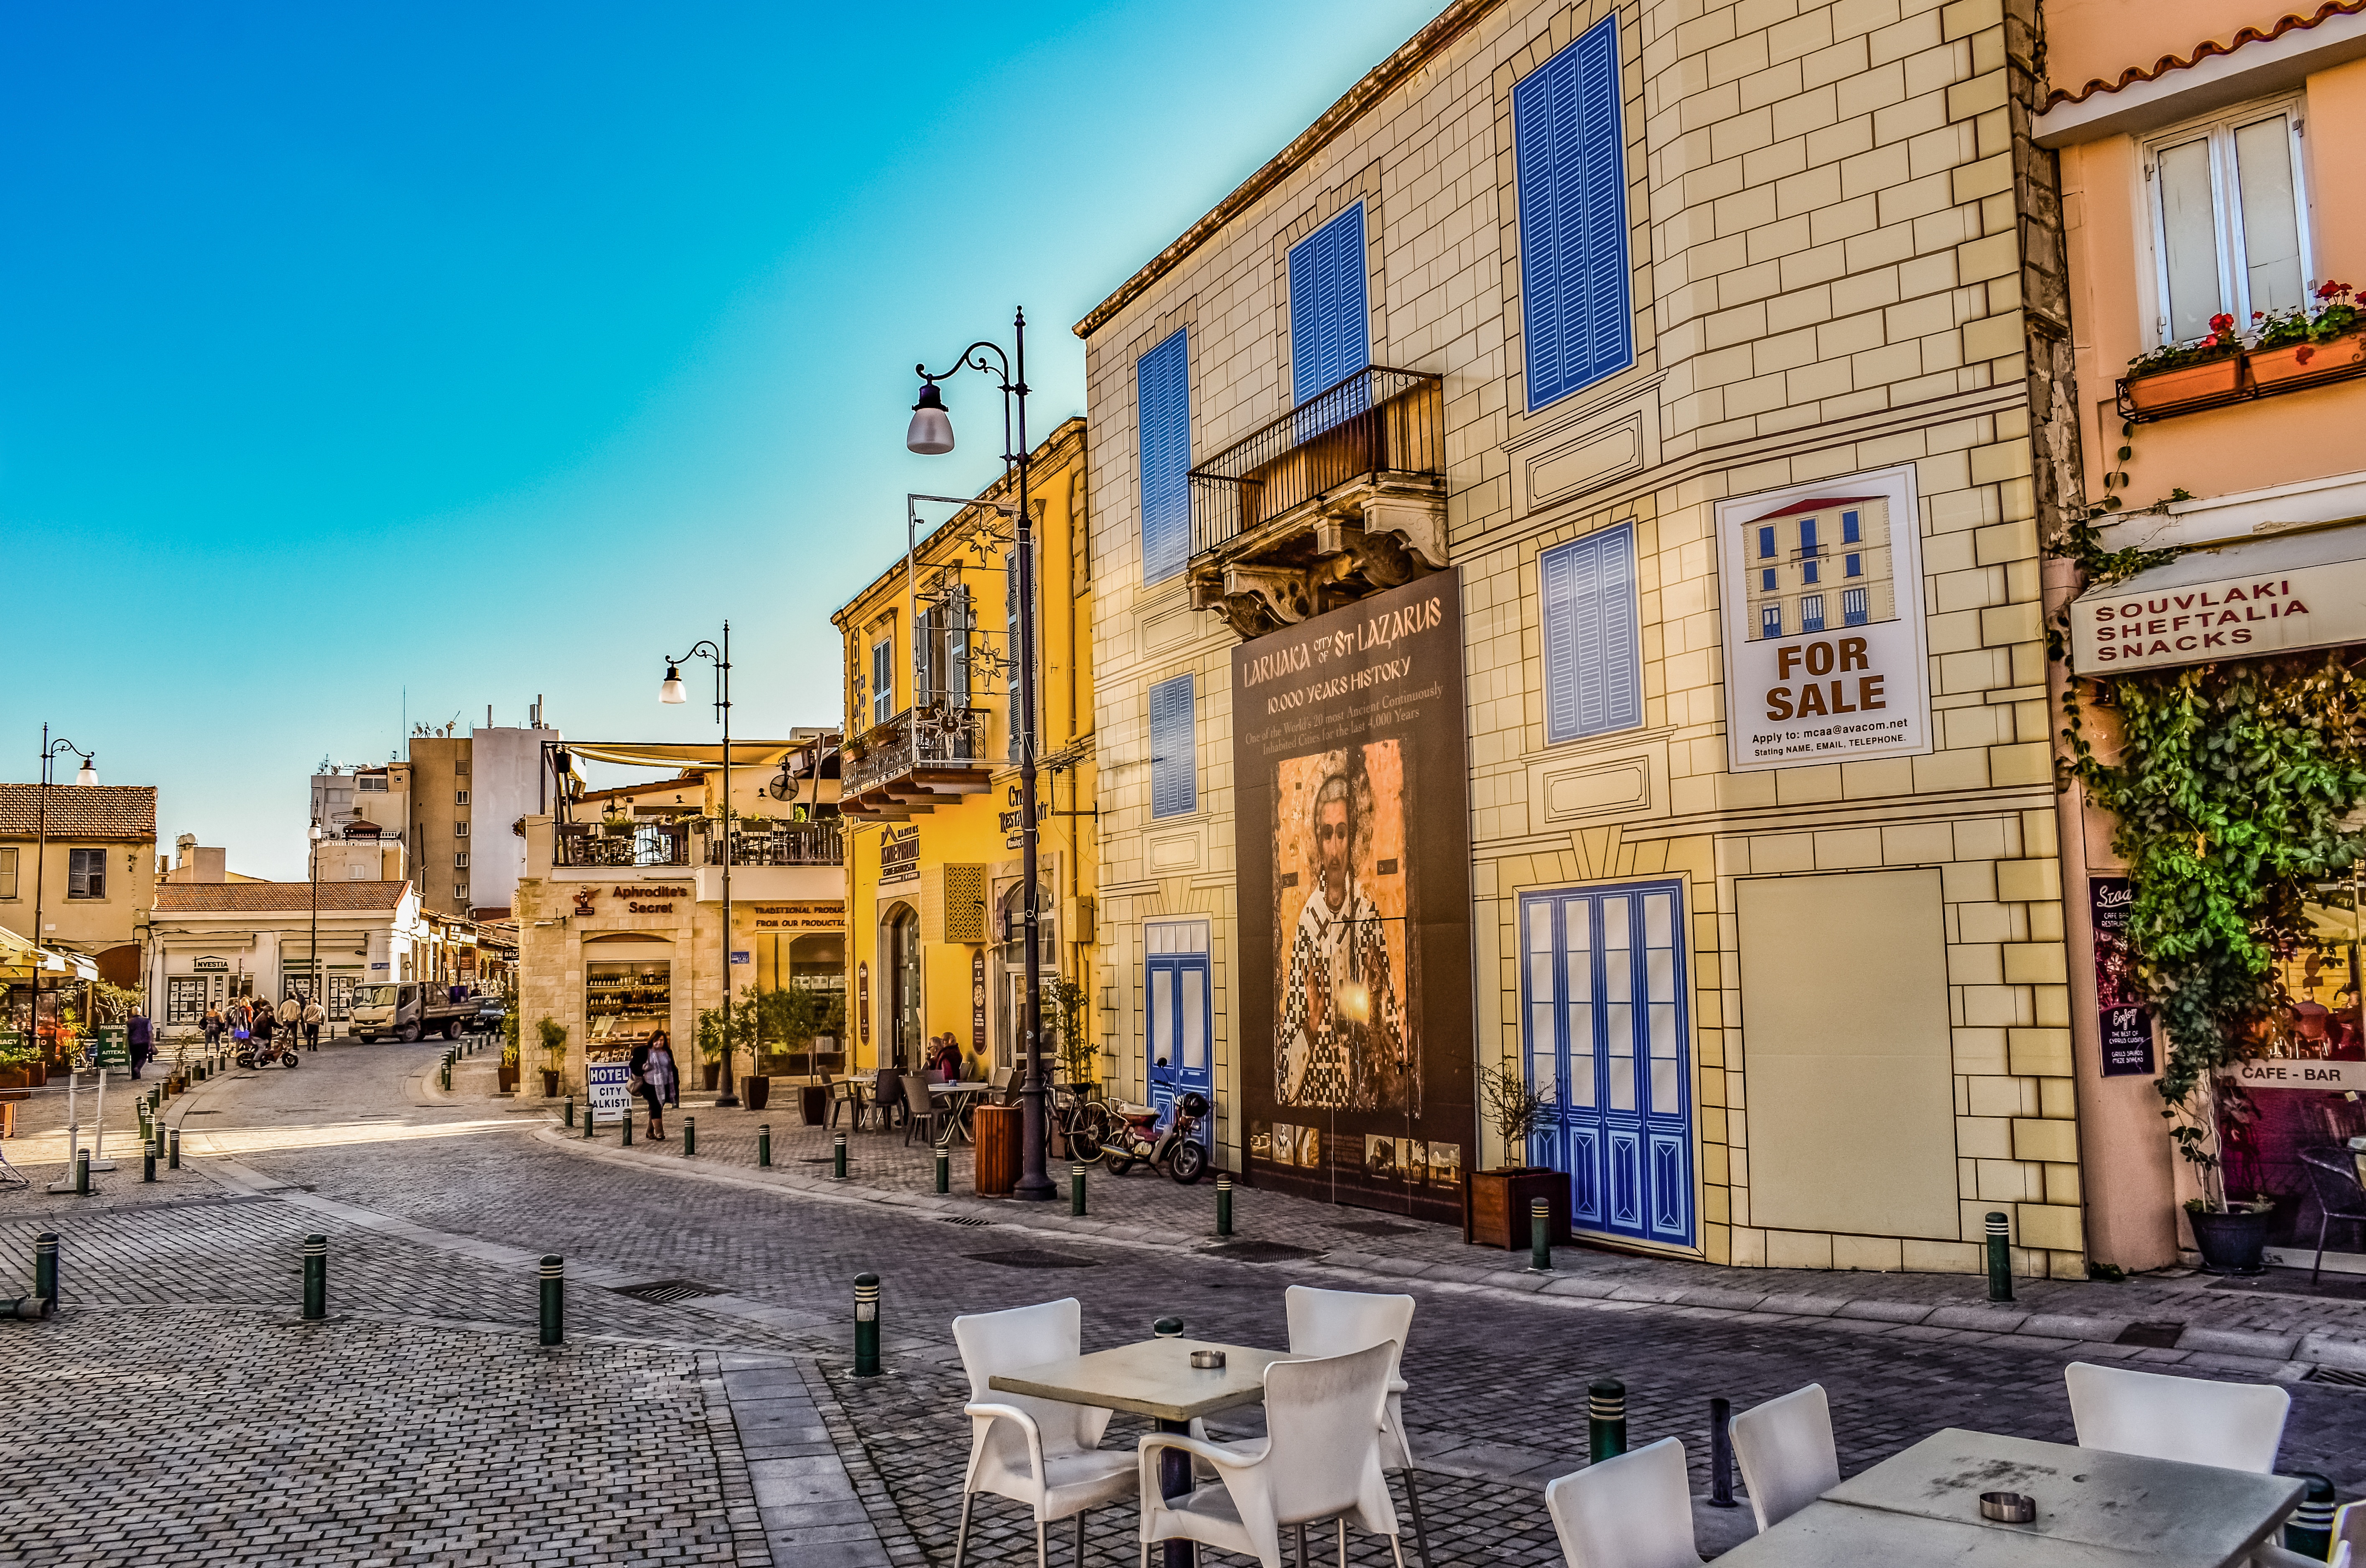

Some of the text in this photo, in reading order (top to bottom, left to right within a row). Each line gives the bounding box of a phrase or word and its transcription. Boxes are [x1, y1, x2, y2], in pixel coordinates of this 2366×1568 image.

[2096, 580, 2289, 621] SOUVLAKI
[1358, 597, 1442, 652] LAZARUS
[2096, 600, 2309, 641] SHEFTALIA
[1314, 635, 1332, 652] CITY
[2098, 629, 2252, 661] SNACKS
[1244, 643, 1310, 687] LARNAKA
[1318, 651, 1328, 663] OF
[1777, 636, 1869, 681] FOR
[1268, 656, 1411, 715] 10.000 YEARS HISTORY
[1766, 675, 1886, 721] SALE
[1245, 681, 1443, 744] One of the World's 20 most Ancient Continuously
[1263, 735, 1296, 755] Inhabited
[1299, 732, 1320, 746] Cities
[1322, 728, 1334, 740] for
[1336, 723, 1349, 737] the
[1351, 720, 1365, 733] last
[1394, 708, 1420, 722] Years
[1752, 733, 1782, 744] Apply
[1804, 718, 1908, 738] mcaa@avacom.net
[1755, 734, 1906, 756] Stating NAME, EMAIL, TELEPHONE.
[613, 886, 687, 899] Aphrodite's
[629, 901, 672, 913] Secret
[2113, 1008, 2137, 1030] Enjoy
[591, 1069, 629, 1082] HOTEL
[2242, 1067, 2287, 1079] CAFE
[2305, 1069, 2341, 1081] BAR
[593, 1099, 629, 1108] ALKISTI
[600, 1087, 621, 1096] CITY
